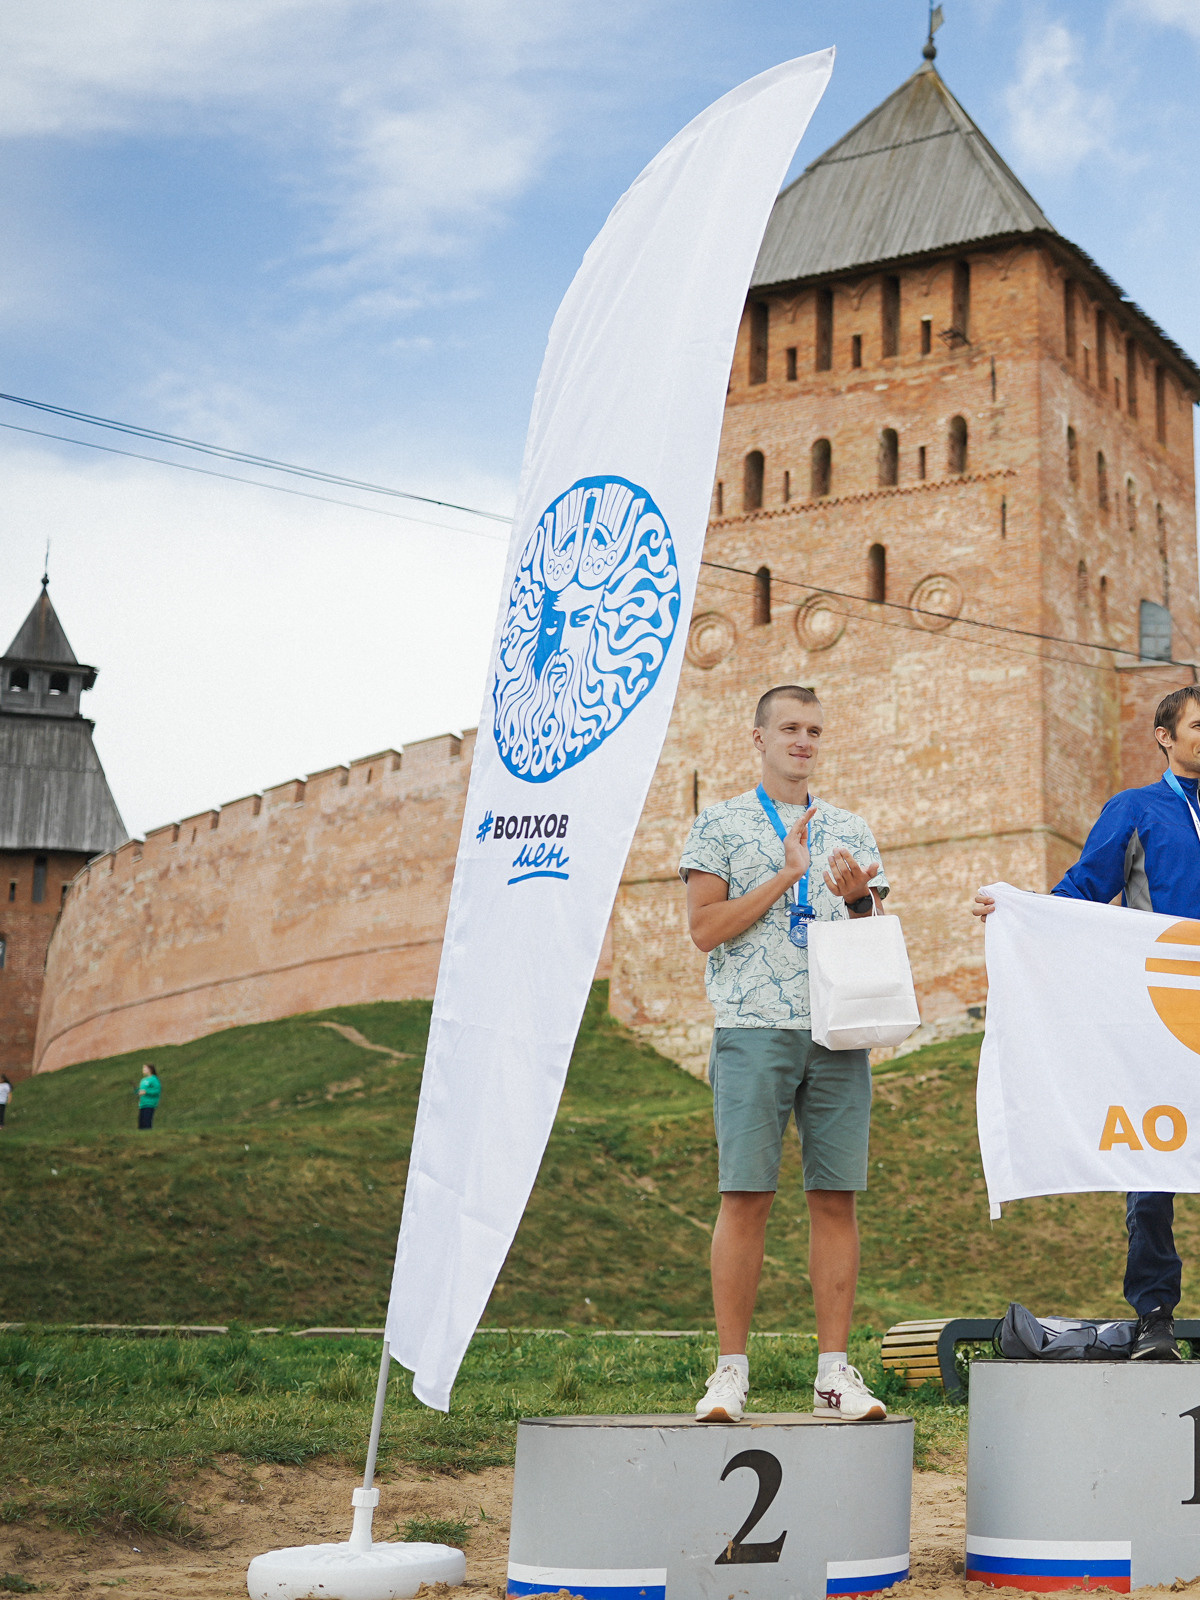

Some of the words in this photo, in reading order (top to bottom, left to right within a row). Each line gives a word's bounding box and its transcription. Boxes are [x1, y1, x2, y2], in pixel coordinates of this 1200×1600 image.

[476, 810, 569, 844] #ВОЛХОВ
[512, 842, 570, 868] мен
[1098, 1104, 1188, 1152] АО
[714, 1449, 788, 1565] 2
